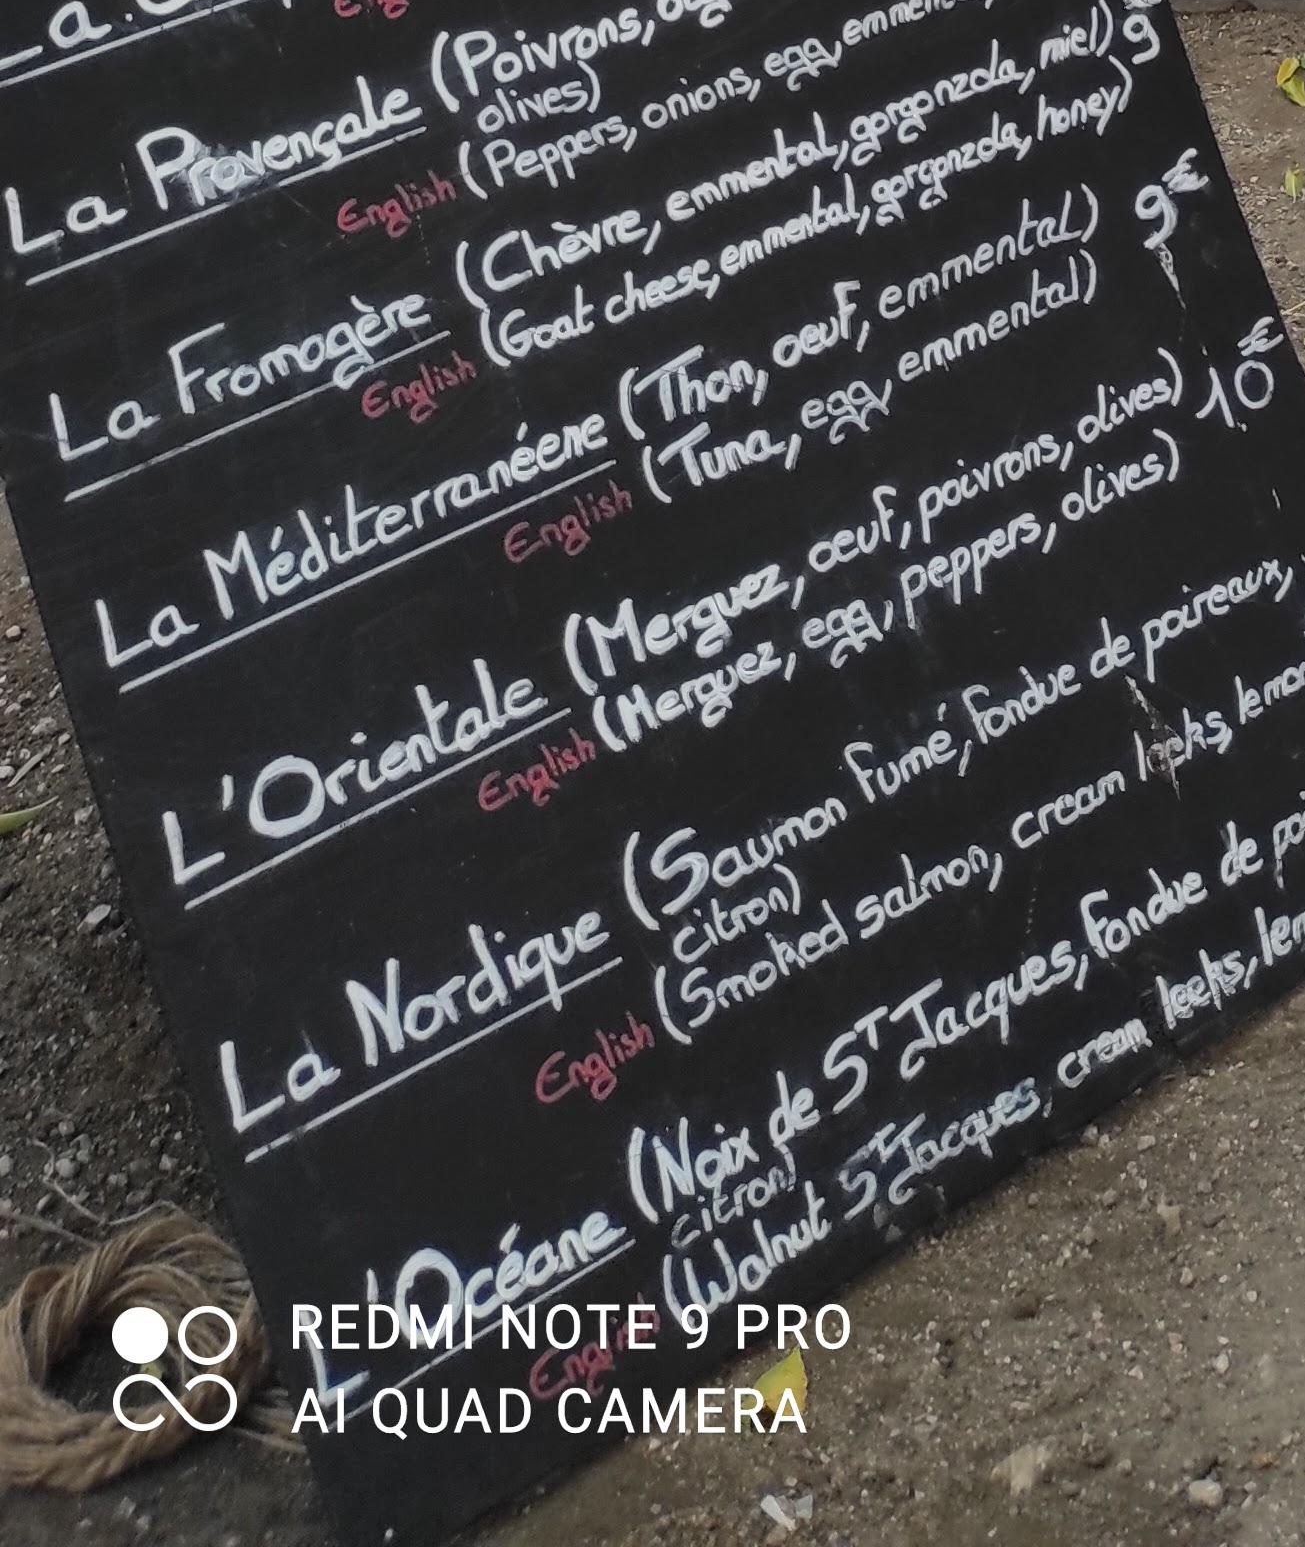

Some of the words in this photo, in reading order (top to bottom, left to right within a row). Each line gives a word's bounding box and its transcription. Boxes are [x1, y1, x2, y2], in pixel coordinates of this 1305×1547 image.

[0, 0, 112, 73] a
[4, 187, 127, 253] La
[431, 8, 655, 108] (Poivrons,
[337, 176, 455, 237] English
[459, 88, 637, 199] (Peppers,
[642, 67, 760, 128] onions,
[477, 53, 600, 148] olives)
[49, 393, 160, 460] La
[168, 294, 430, 414] Fromagère
[456, 210, 661, 311] (Chèvre,
[666, 111, 848, 220] emmental,
[361, 354, 475, 422] English
[480, 284, 594, 368] (Goat
[720, 173, 870, 275] emmental,
[1019, 55, 1132, 140] honey)
[504, 487, 629, 561] English
[642, 393, 801, 503] (Tuna,
[898, 249, 1096, 380] emmental)
[96, 599, 199, 667] La
[619, 345, 768, 460] (Thon,
[879, 183, 1098, 318] emmental)
[163, 658, 548, 884] L'Orientale
[564, 564, 805, 695] (Merguez,
[918, 434, 1073, 543] poivrons,
[1077, 347, 1182, 443] olives)
[478, 732, 595, 810] English
[592, 641, 796, 751] (Merguez,
[900, 513, 1056, 629] peppers,
[1062, 428, 1179, 520] olives)
[220, 1041, 340, 1133] La
[346, 911, 609, 1066] Nordique
[624, 798, 847, 930] (Saumon
[1090, 617, 1135, 677] de
[535, 1017, 653, 1103] English
[855, 845, 1002, 938] salmon,
[1012, 771, 1125, 848] cream
[628, 1117, 759, 1221] (Noix
[769, 1071, 820, 1147] de
[1221, 820, 1263, 885] de
[673, 864, 800, 974] citron)
